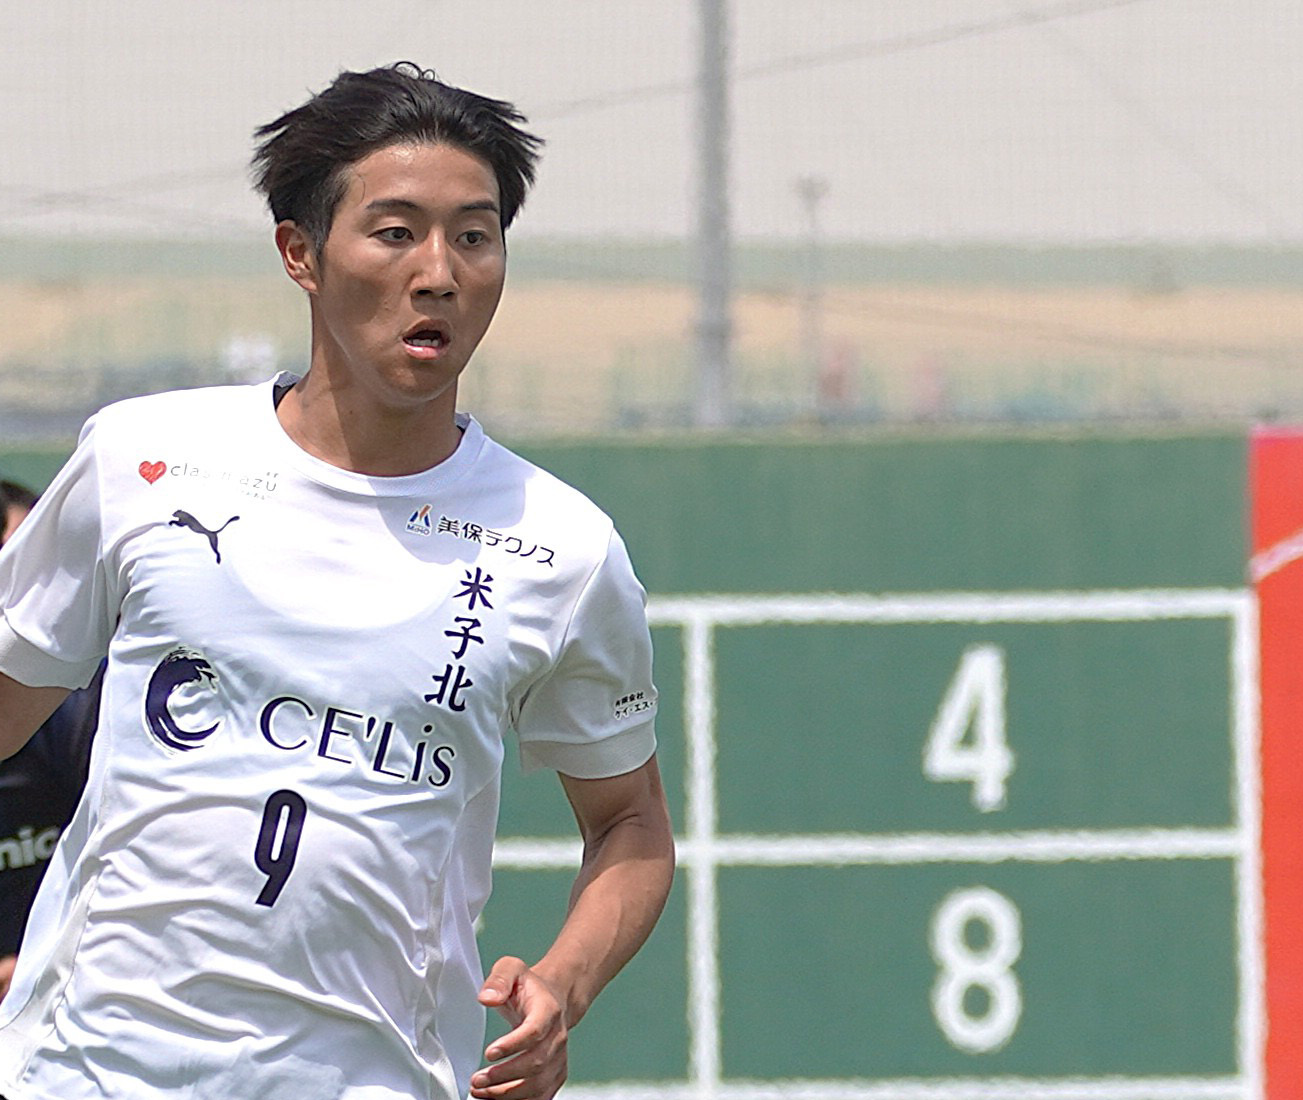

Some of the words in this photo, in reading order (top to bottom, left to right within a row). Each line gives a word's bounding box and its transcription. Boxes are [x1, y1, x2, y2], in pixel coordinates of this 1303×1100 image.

[437, 516, 554, 568] 美保テクノス
[424, 566, 495, 712] 米子北
[922, 643, 1016, 813] 4
[254, 789, 307, 908] 9
[930, 884, 1024, 1055] 8
